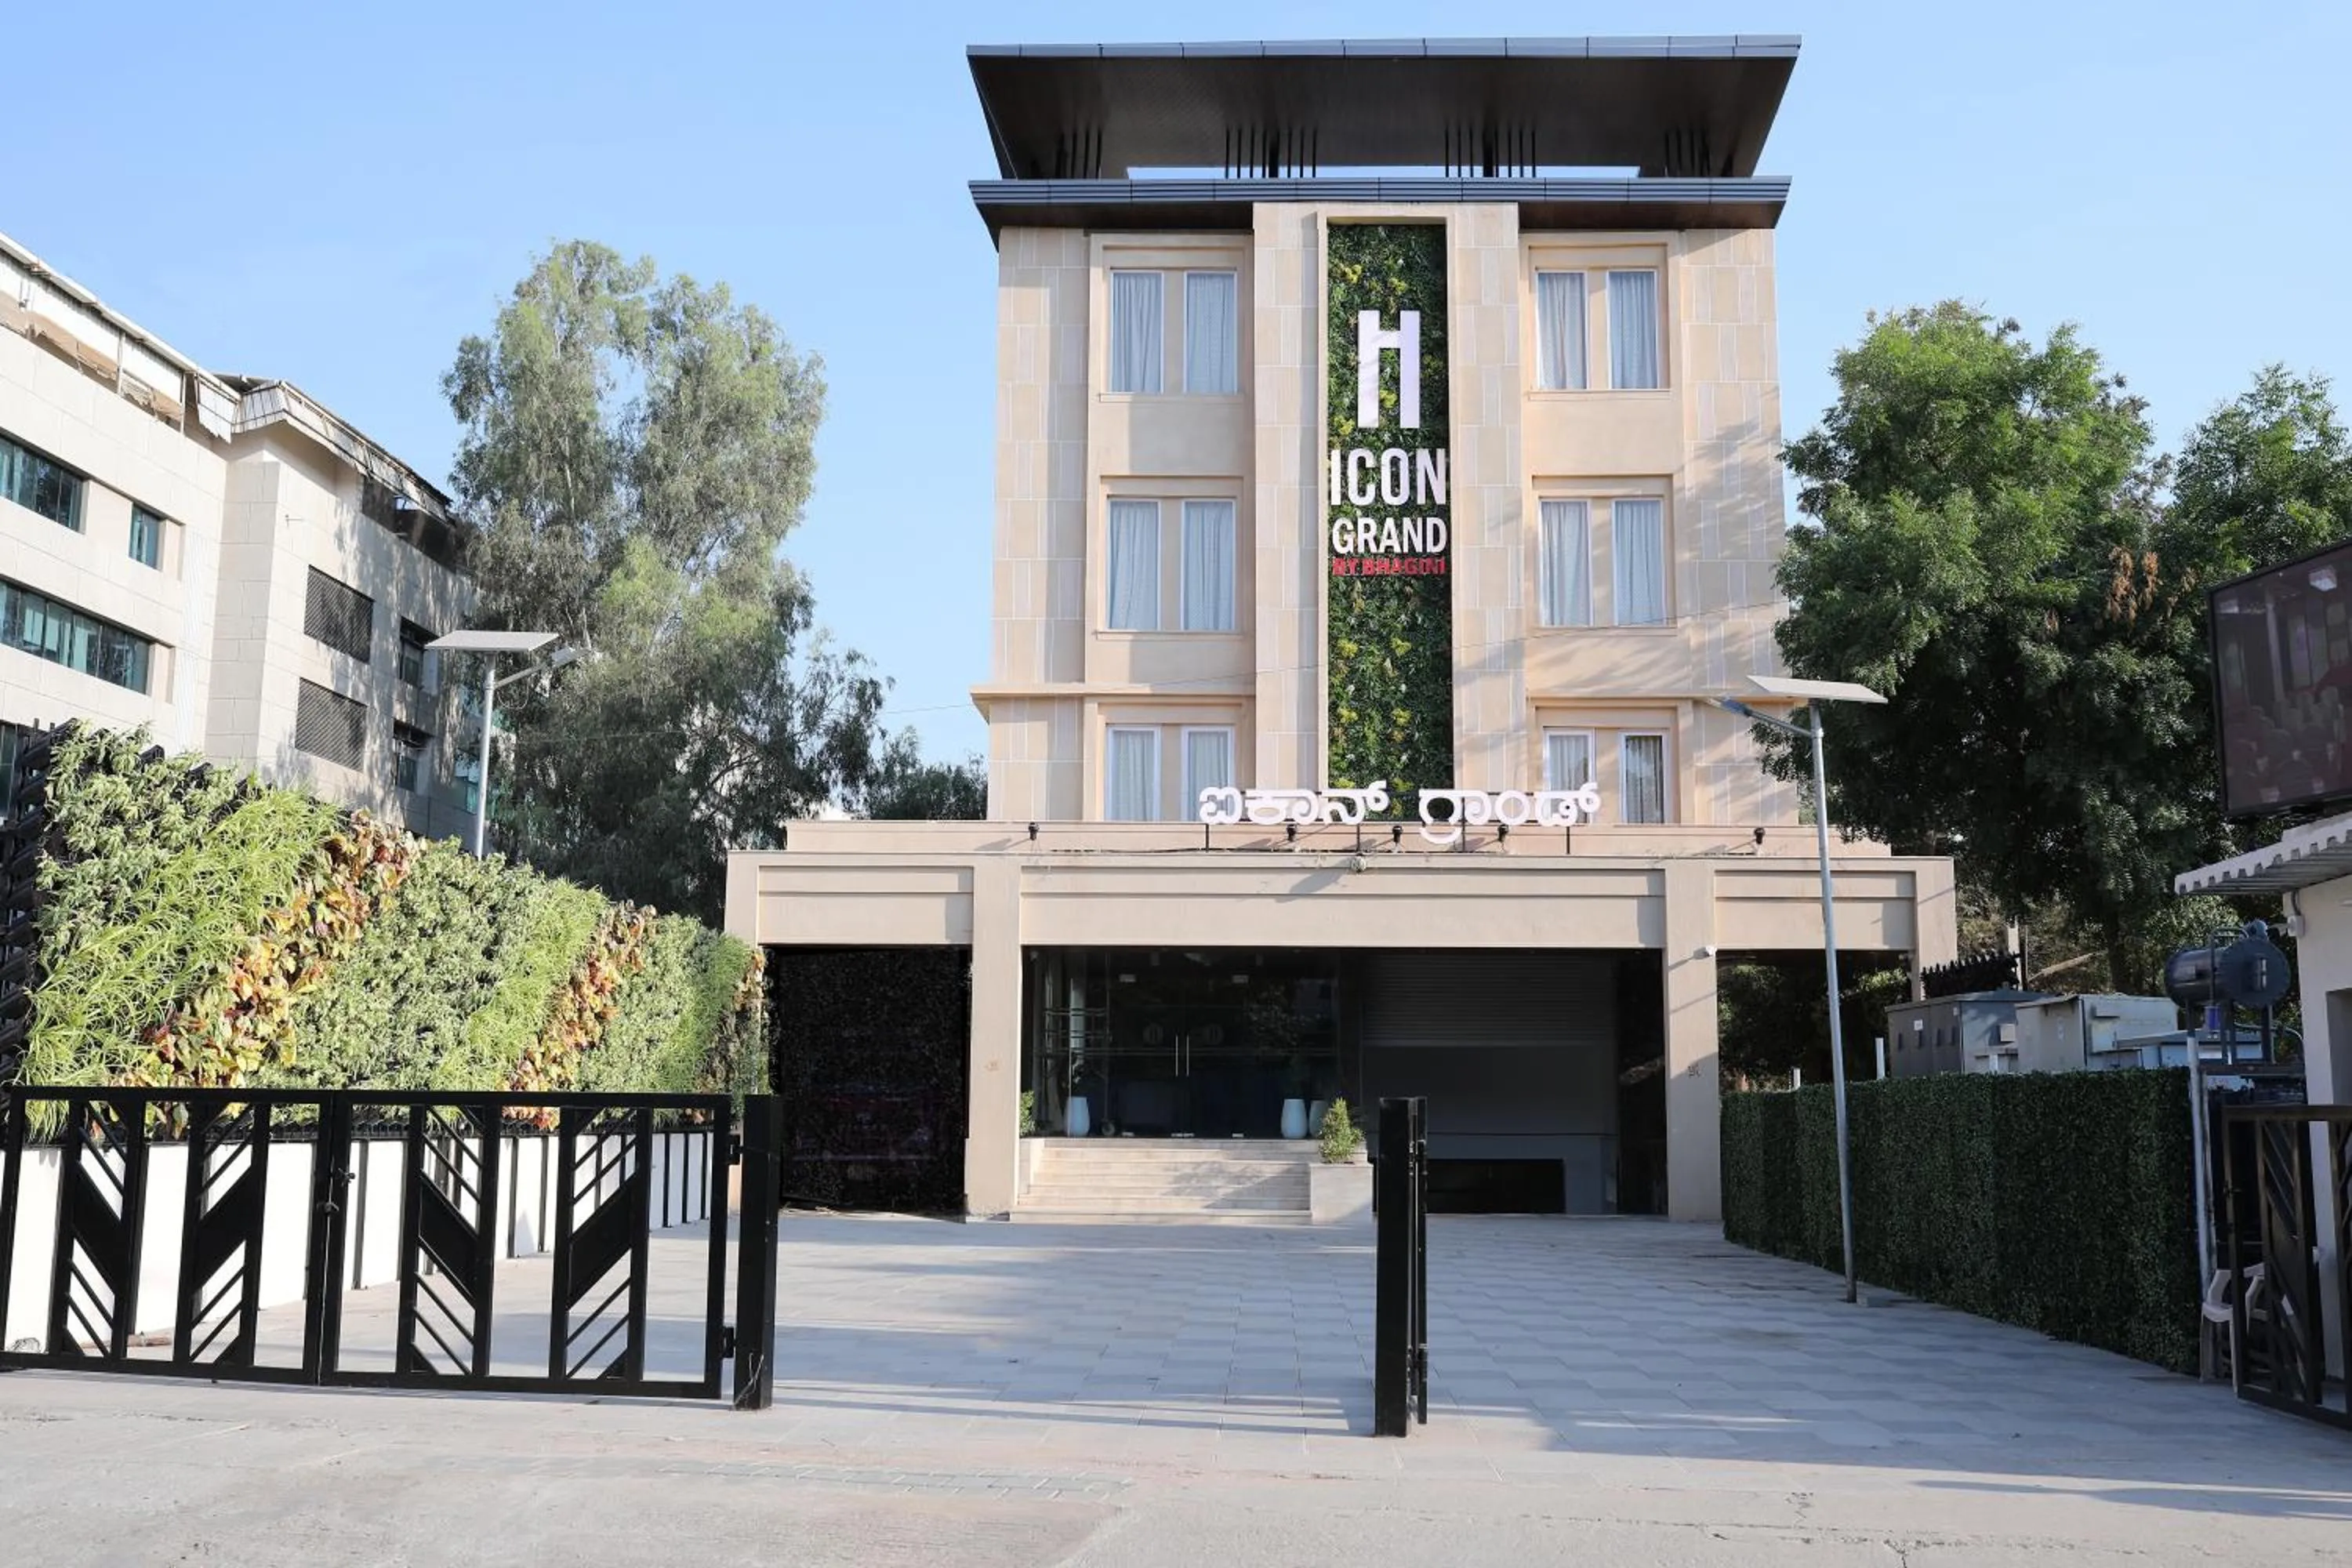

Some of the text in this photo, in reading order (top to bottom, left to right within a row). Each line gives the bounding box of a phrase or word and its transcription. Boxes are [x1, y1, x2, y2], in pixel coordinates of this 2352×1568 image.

[1358, 310, 1420, 428] H
[1330, 448, 1446, 506] ICON
[1333, 517, 1446, 554] GRAND
[1333, 557, 1446, 576] BY BHAGINI
[1199, 781, 1389, 825] ಐಕಾನ್
